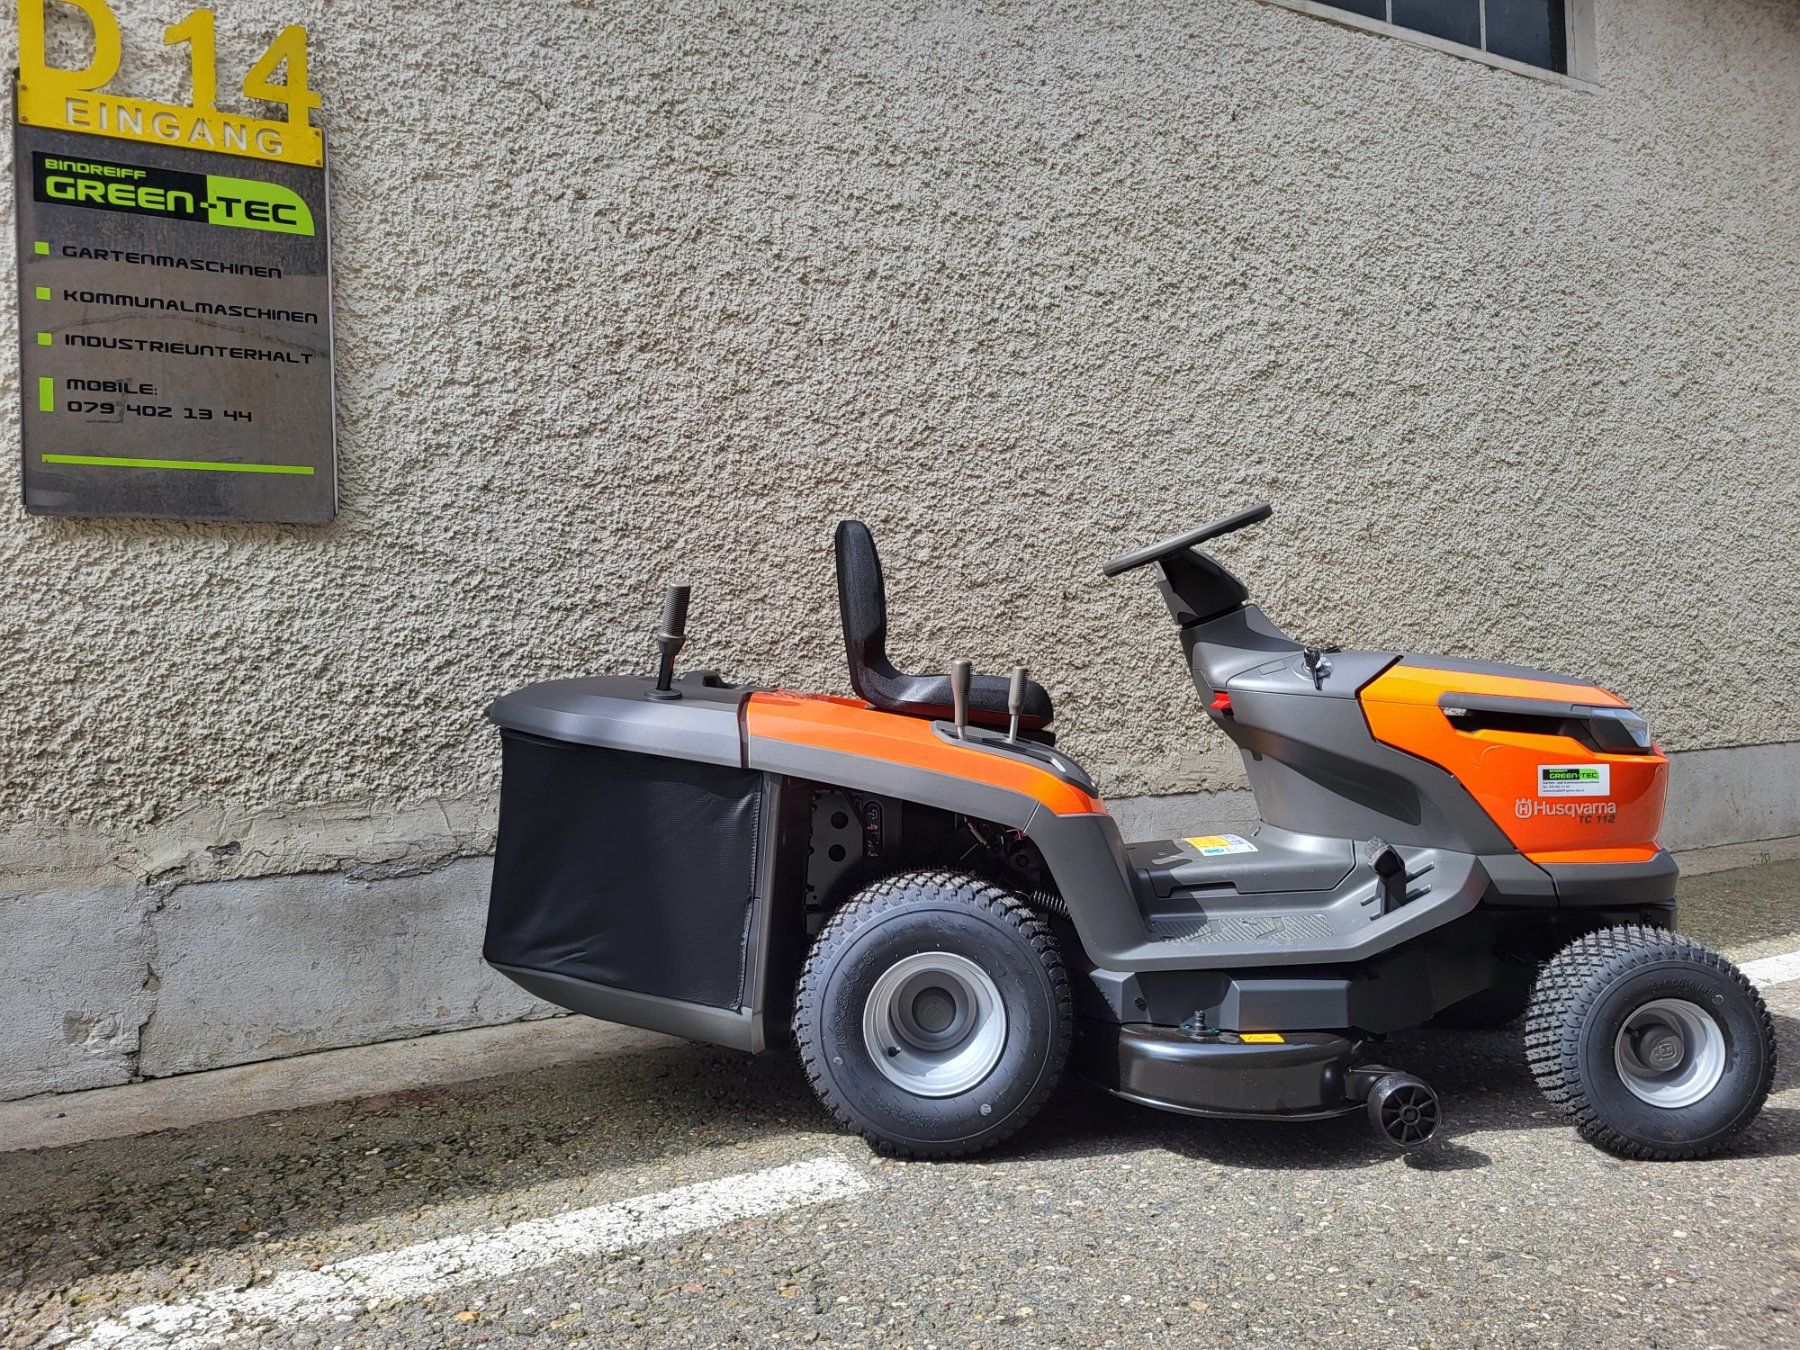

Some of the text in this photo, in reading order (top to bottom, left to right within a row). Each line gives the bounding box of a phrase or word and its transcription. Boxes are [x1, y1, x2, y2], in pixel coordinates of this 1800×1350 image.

[18, 0, 321, 126] D 14
[65, 96, 283, 155] EINGANG
[44, 158, 147, 180] BINDREIFF
[62, 245, 282, 279] GARTENMASCHINEN
[63, 289, 318, 324] KOMMUNALMASCHINEN
[64, 334, 313, 364] INDUSTRIEUNTERHALT
[66, 378, 158, 396] MOBILE:
[67, 400, 252, 422] 079 402 13 44
[1534, 801, 1616, 817] Husqvarna
[1579, 814, 1616, 824] TC 112
